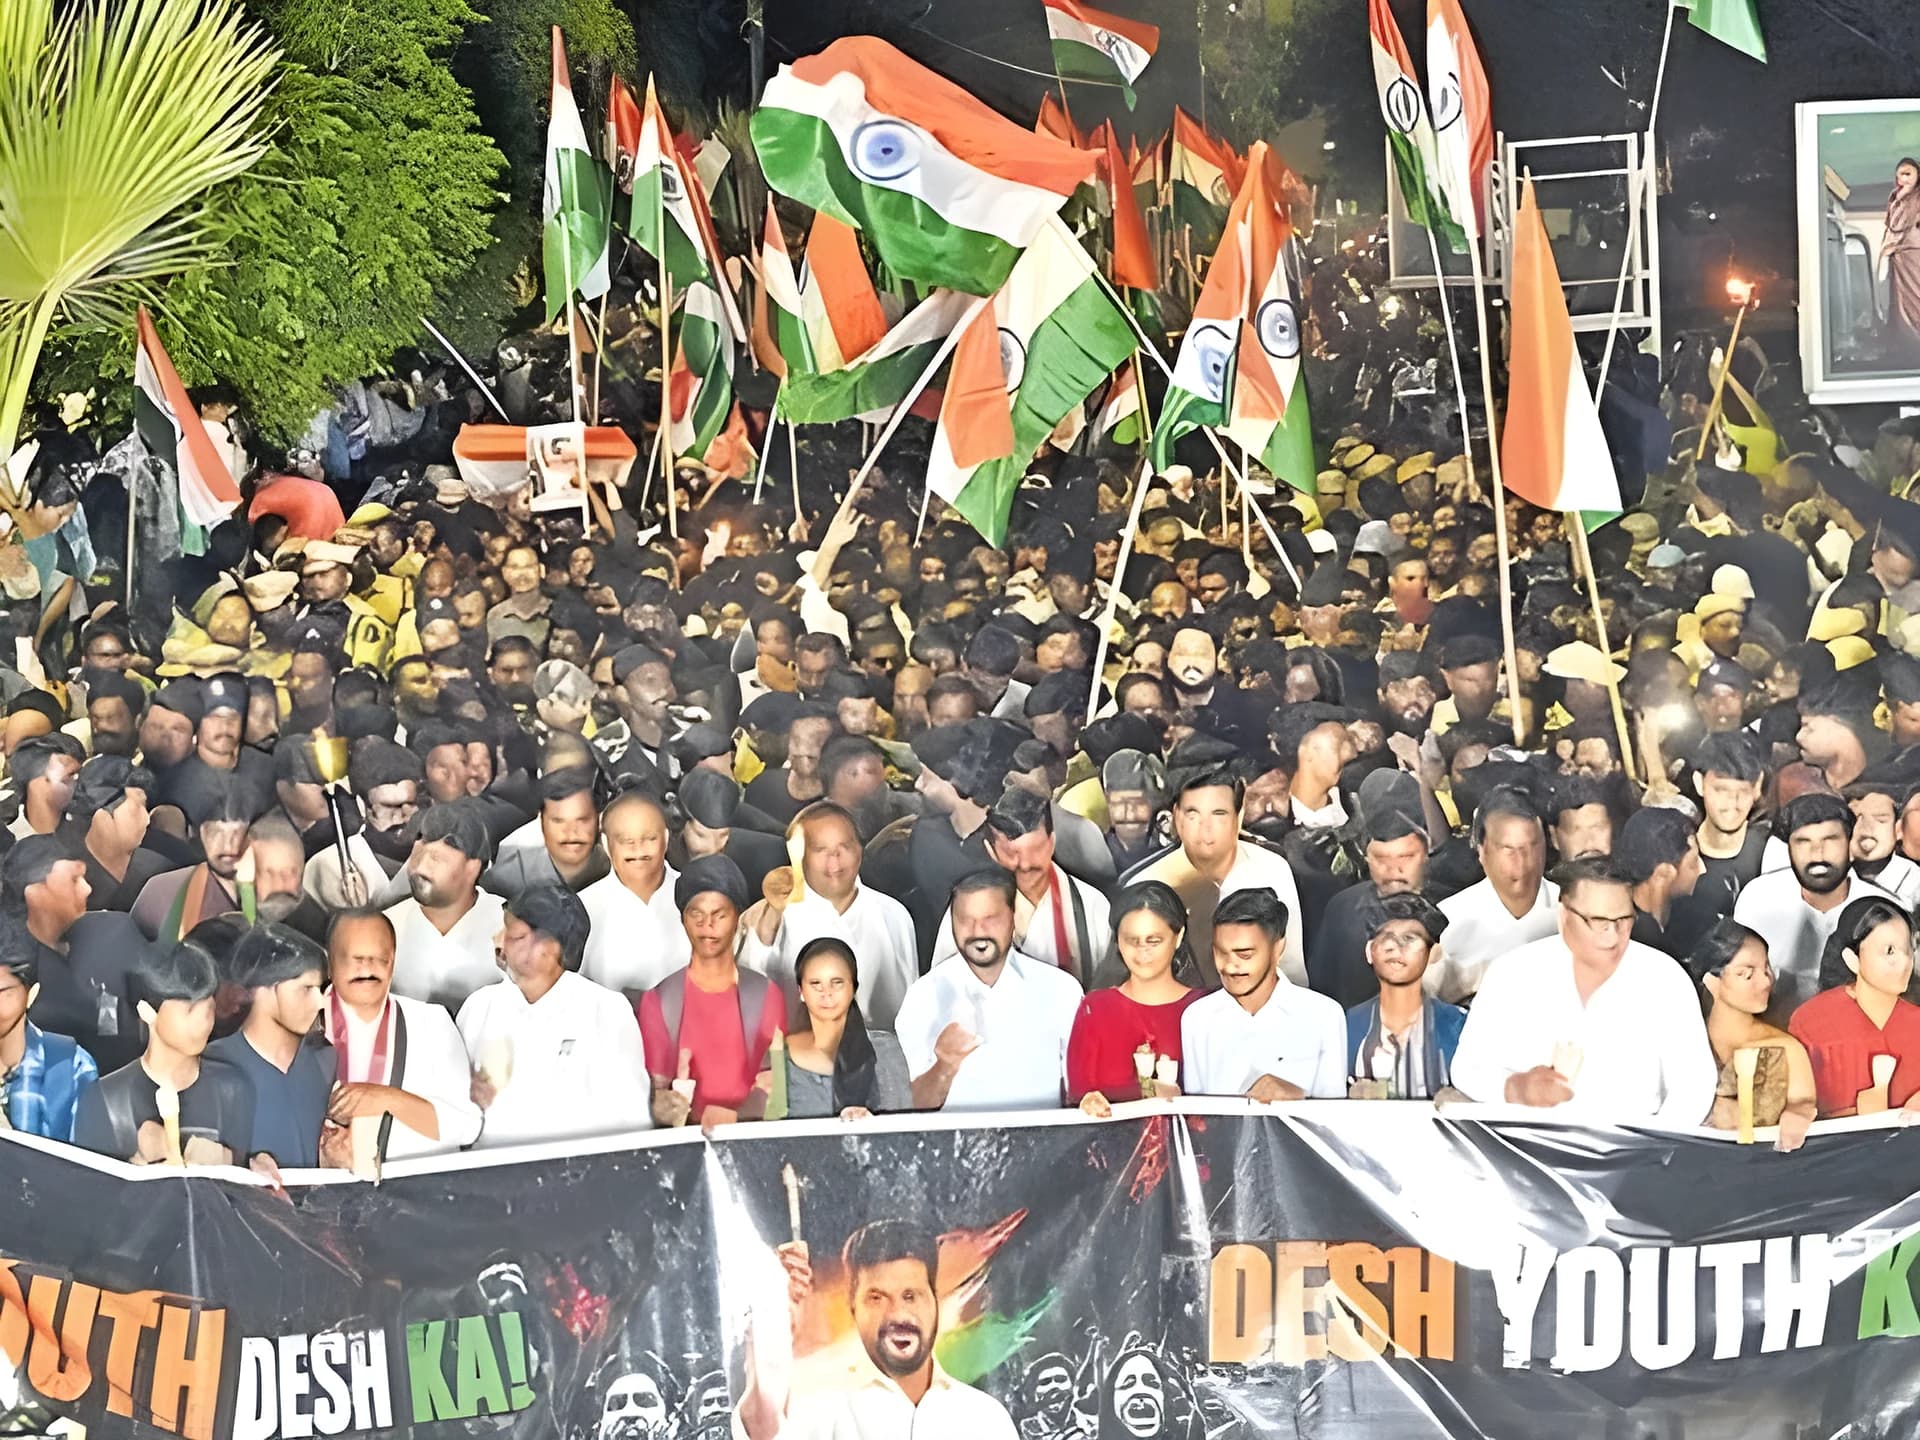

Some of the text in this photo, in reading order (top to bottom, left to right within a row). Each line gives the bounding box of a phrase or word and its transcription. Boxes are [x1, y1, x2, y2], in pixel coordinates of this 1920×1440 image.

[1208, 1240, 1456, 1366] DESH
[1484, 1232, 1832, 1375] YOUTH
[232, 1328, 393, 1440] DESH
[406, 1311, 536, 1423] KA!
